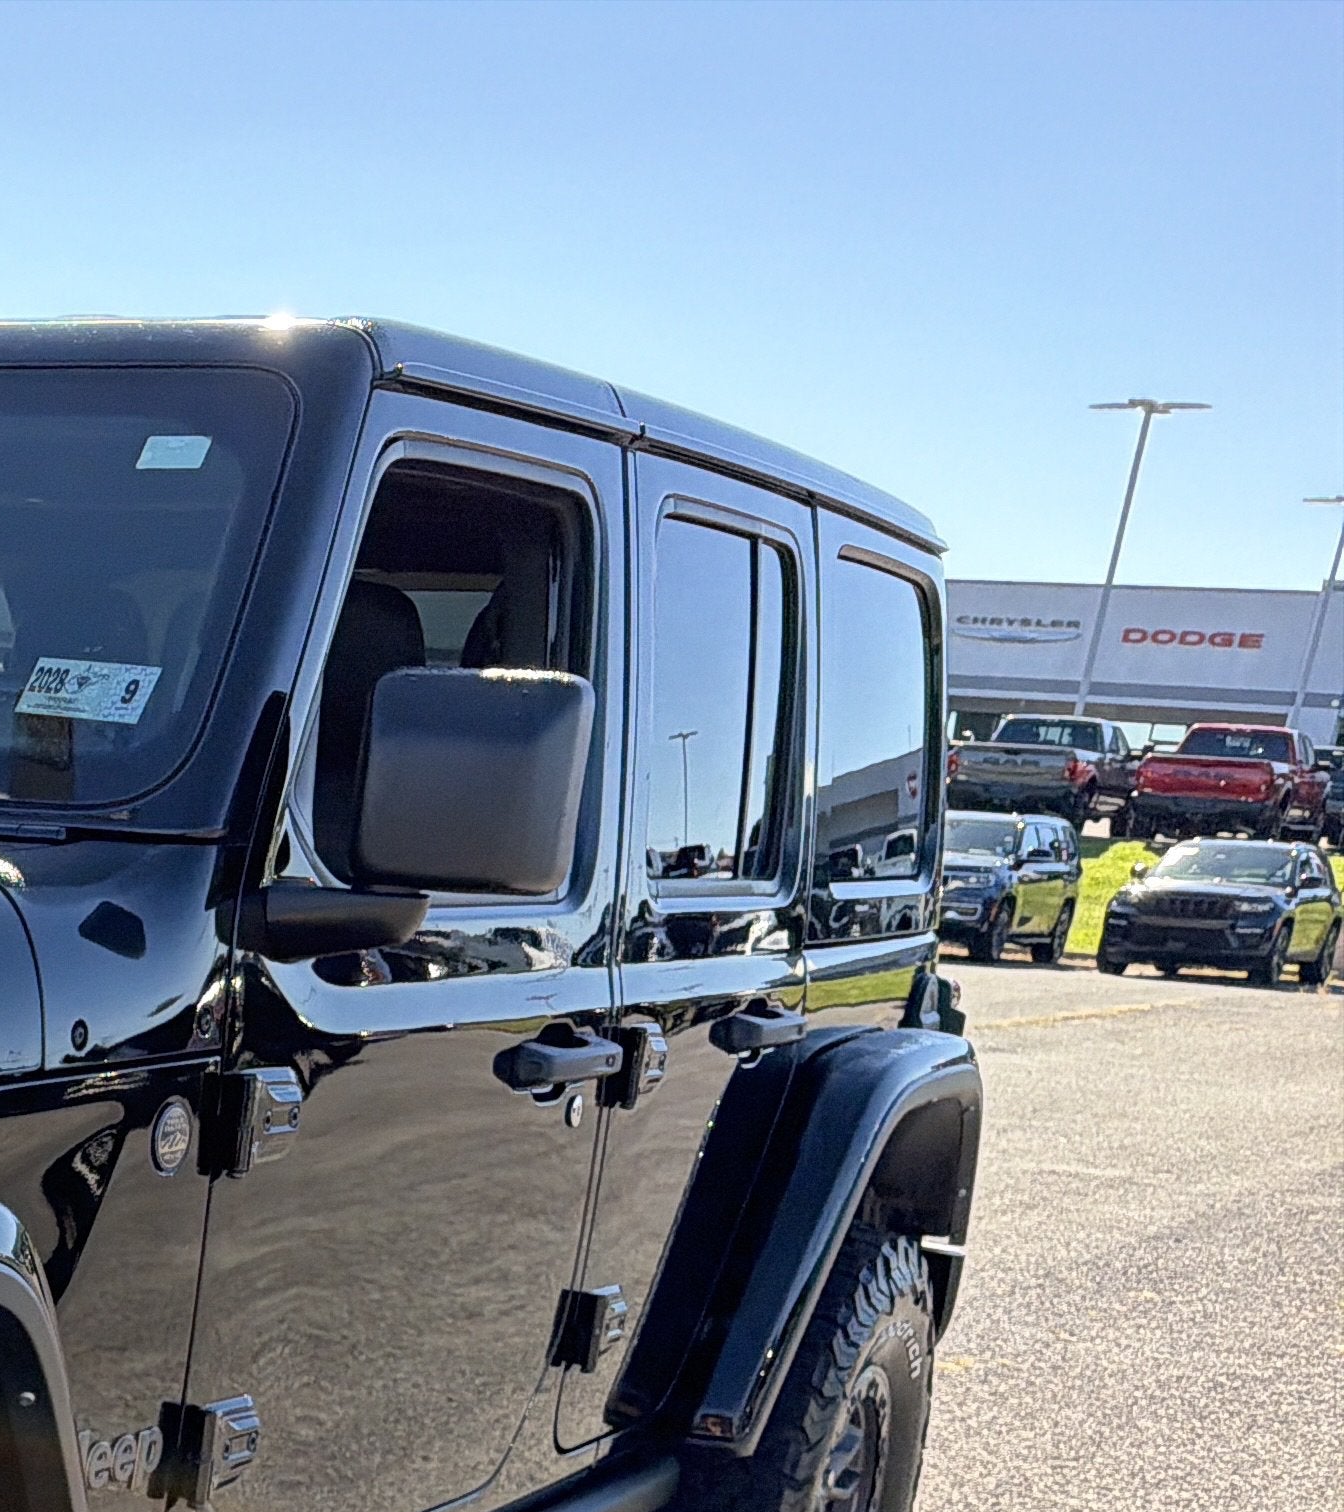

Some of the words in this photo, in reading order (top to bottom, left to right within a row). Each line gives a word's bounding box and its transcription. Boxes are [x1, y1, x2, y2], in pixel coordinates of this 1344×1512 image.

[955, 614, 1082, 629] CHRYSLER
[1121, 627, 1266, 649] DODGE
[28, 666, 70, 695] 2028
[120, 678, 140, 704] 9
